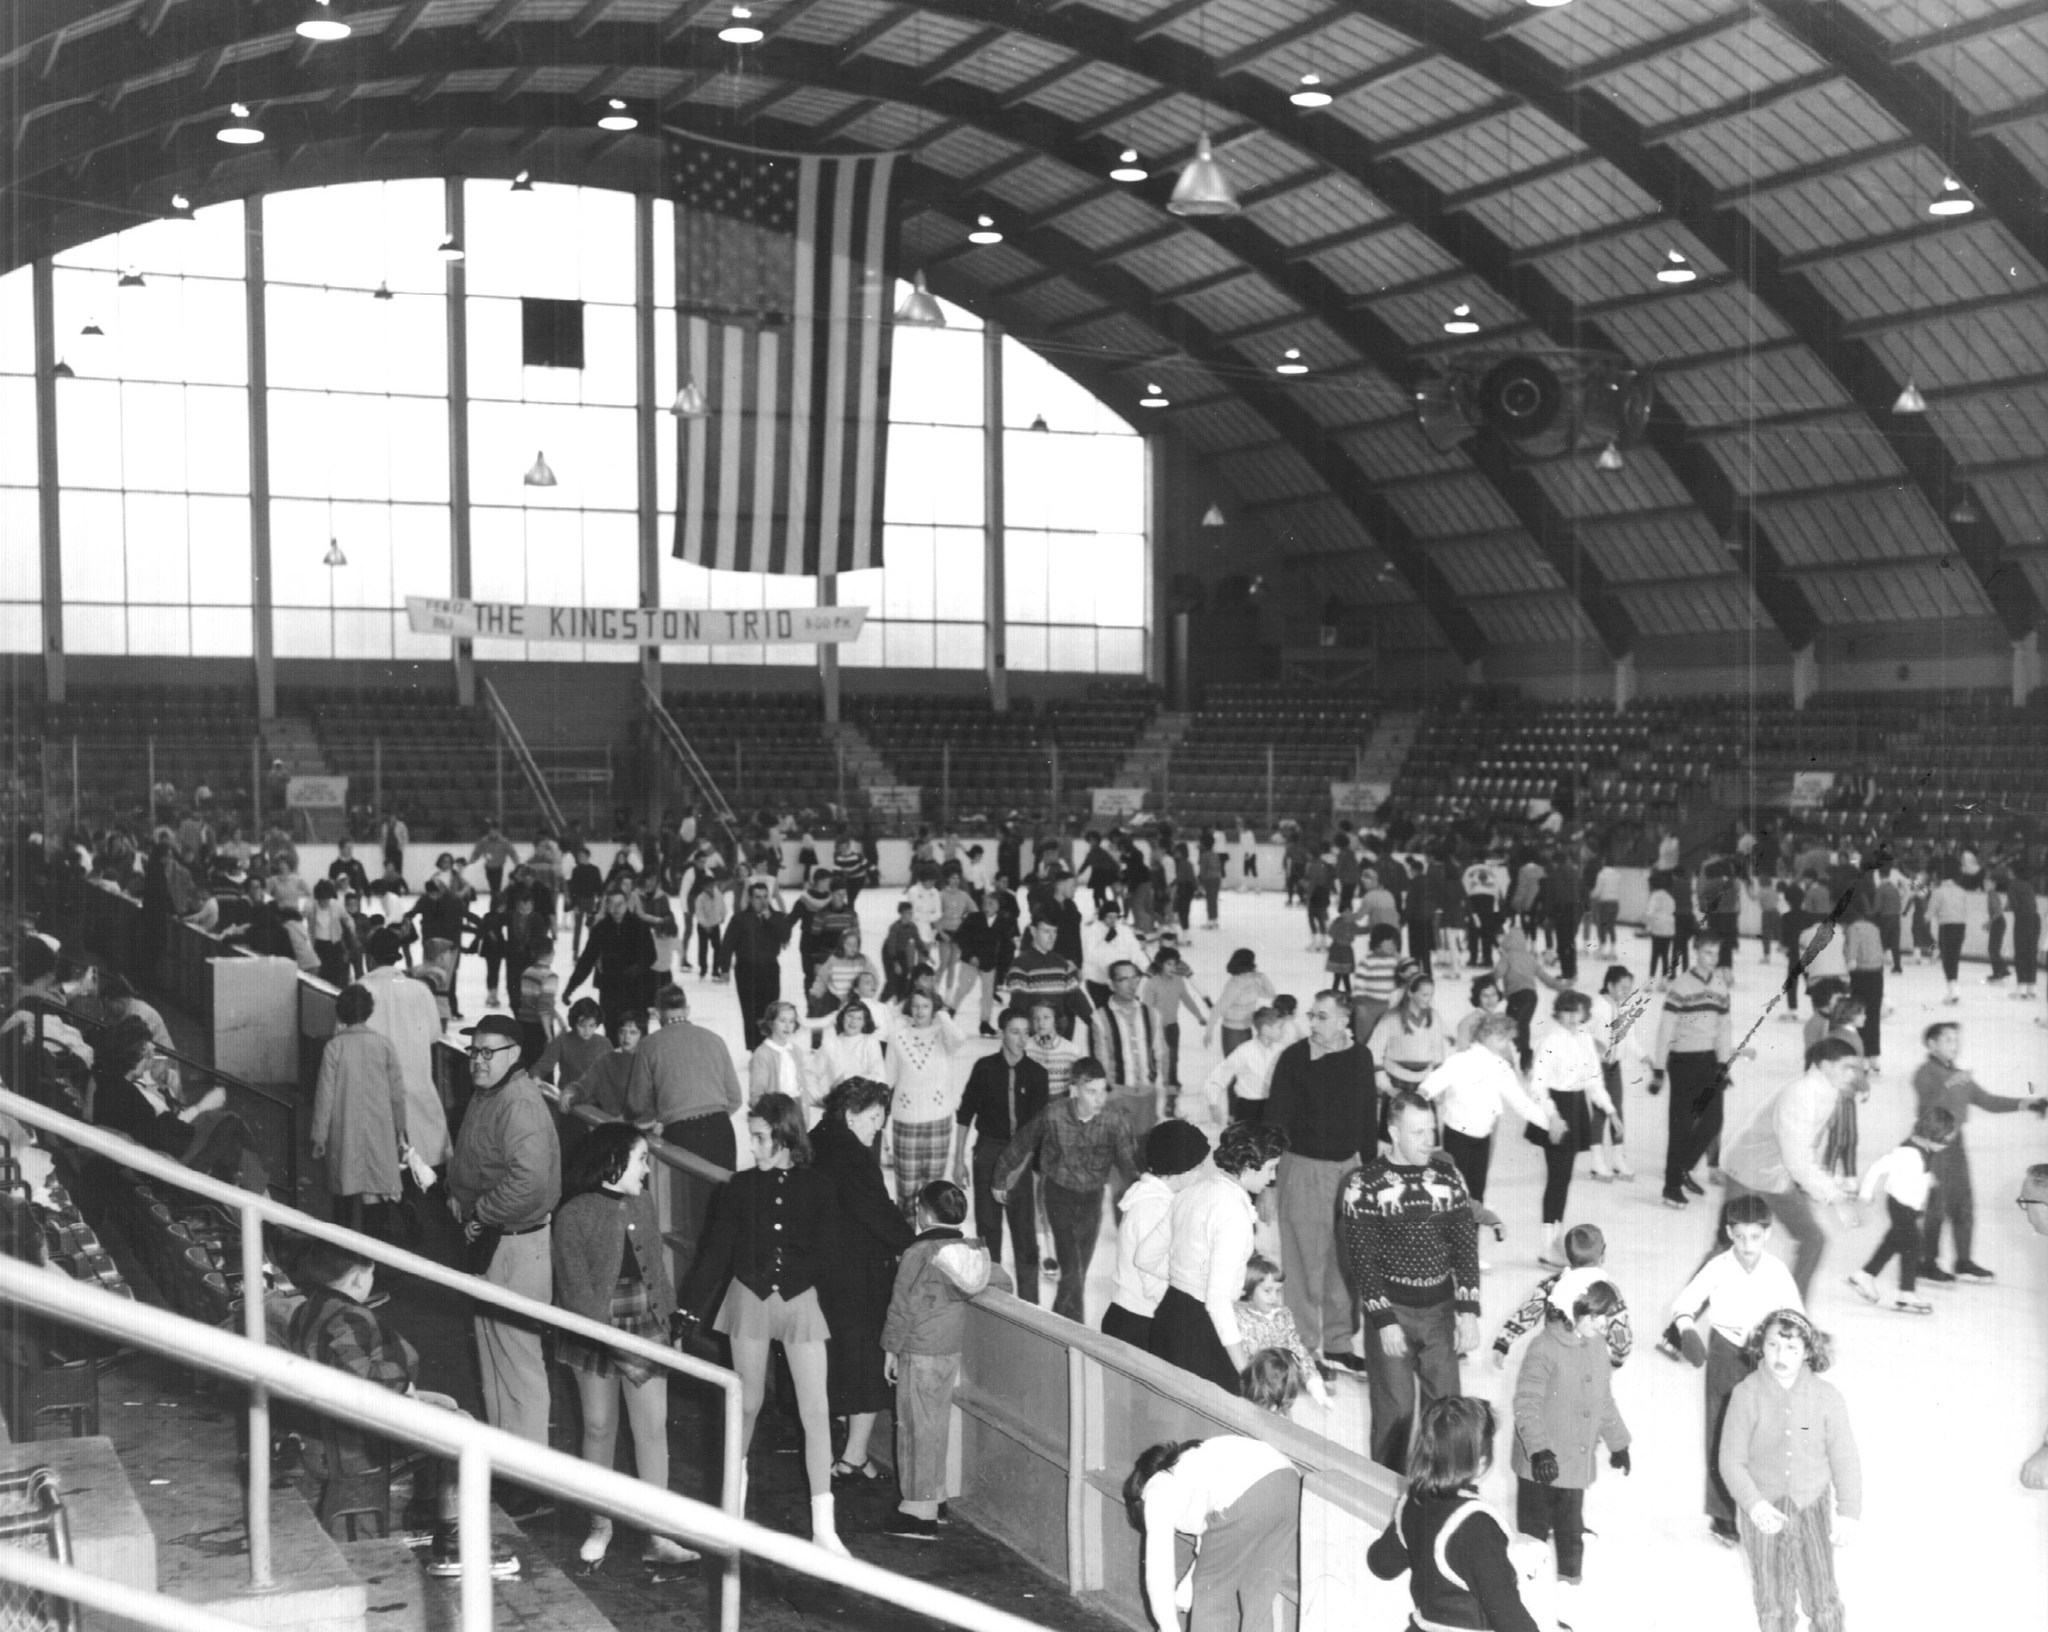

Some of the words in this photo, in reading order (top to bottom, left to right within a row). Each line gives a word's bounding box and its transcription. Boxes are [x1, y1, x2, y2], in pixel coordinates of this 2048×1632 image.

[473, 603, 523, 635] THE
[550, 607, 700, 640] KINGSTON
[725, 610, 792, 640] TRIO
